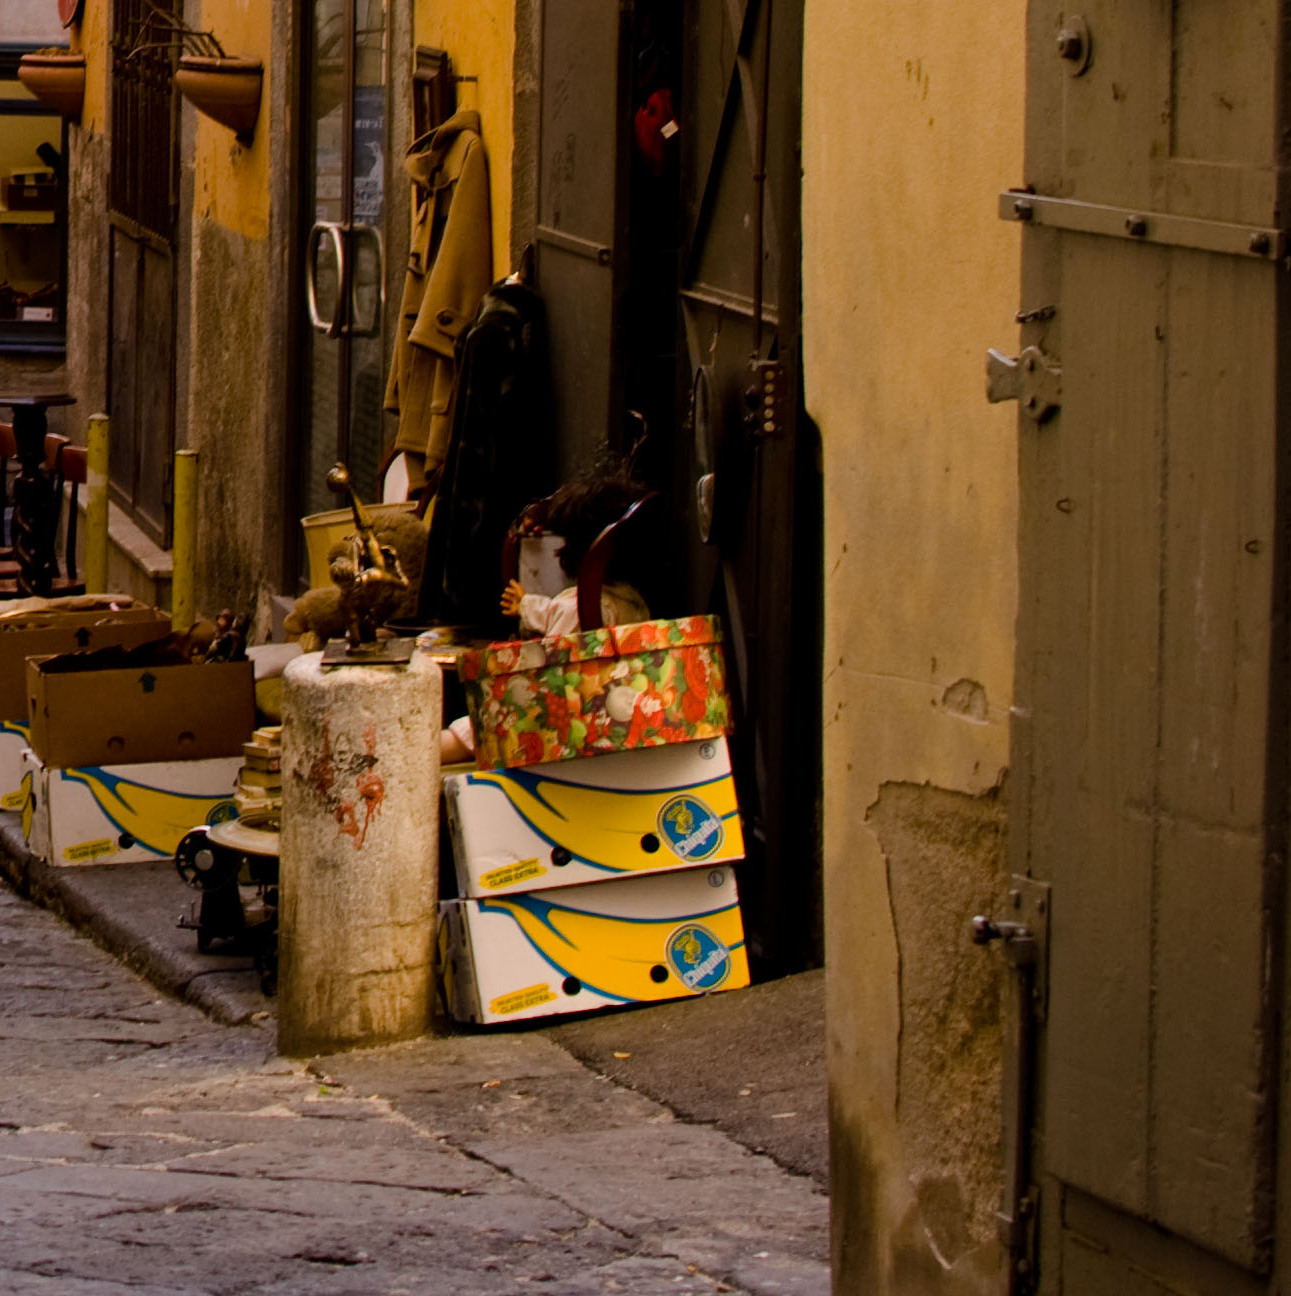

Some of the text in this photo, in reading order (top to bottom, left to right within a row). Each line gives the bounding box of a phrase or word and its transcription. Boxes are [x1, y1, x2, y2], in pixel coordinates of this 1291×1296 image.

[674, 814, 721, 856] Chiquita
[489, 866, 539, 887] CLASS EXTRA
[682, 945, 729, 988] Chiquita
[500, 994, 550, 1014] CLASS EXTRA
